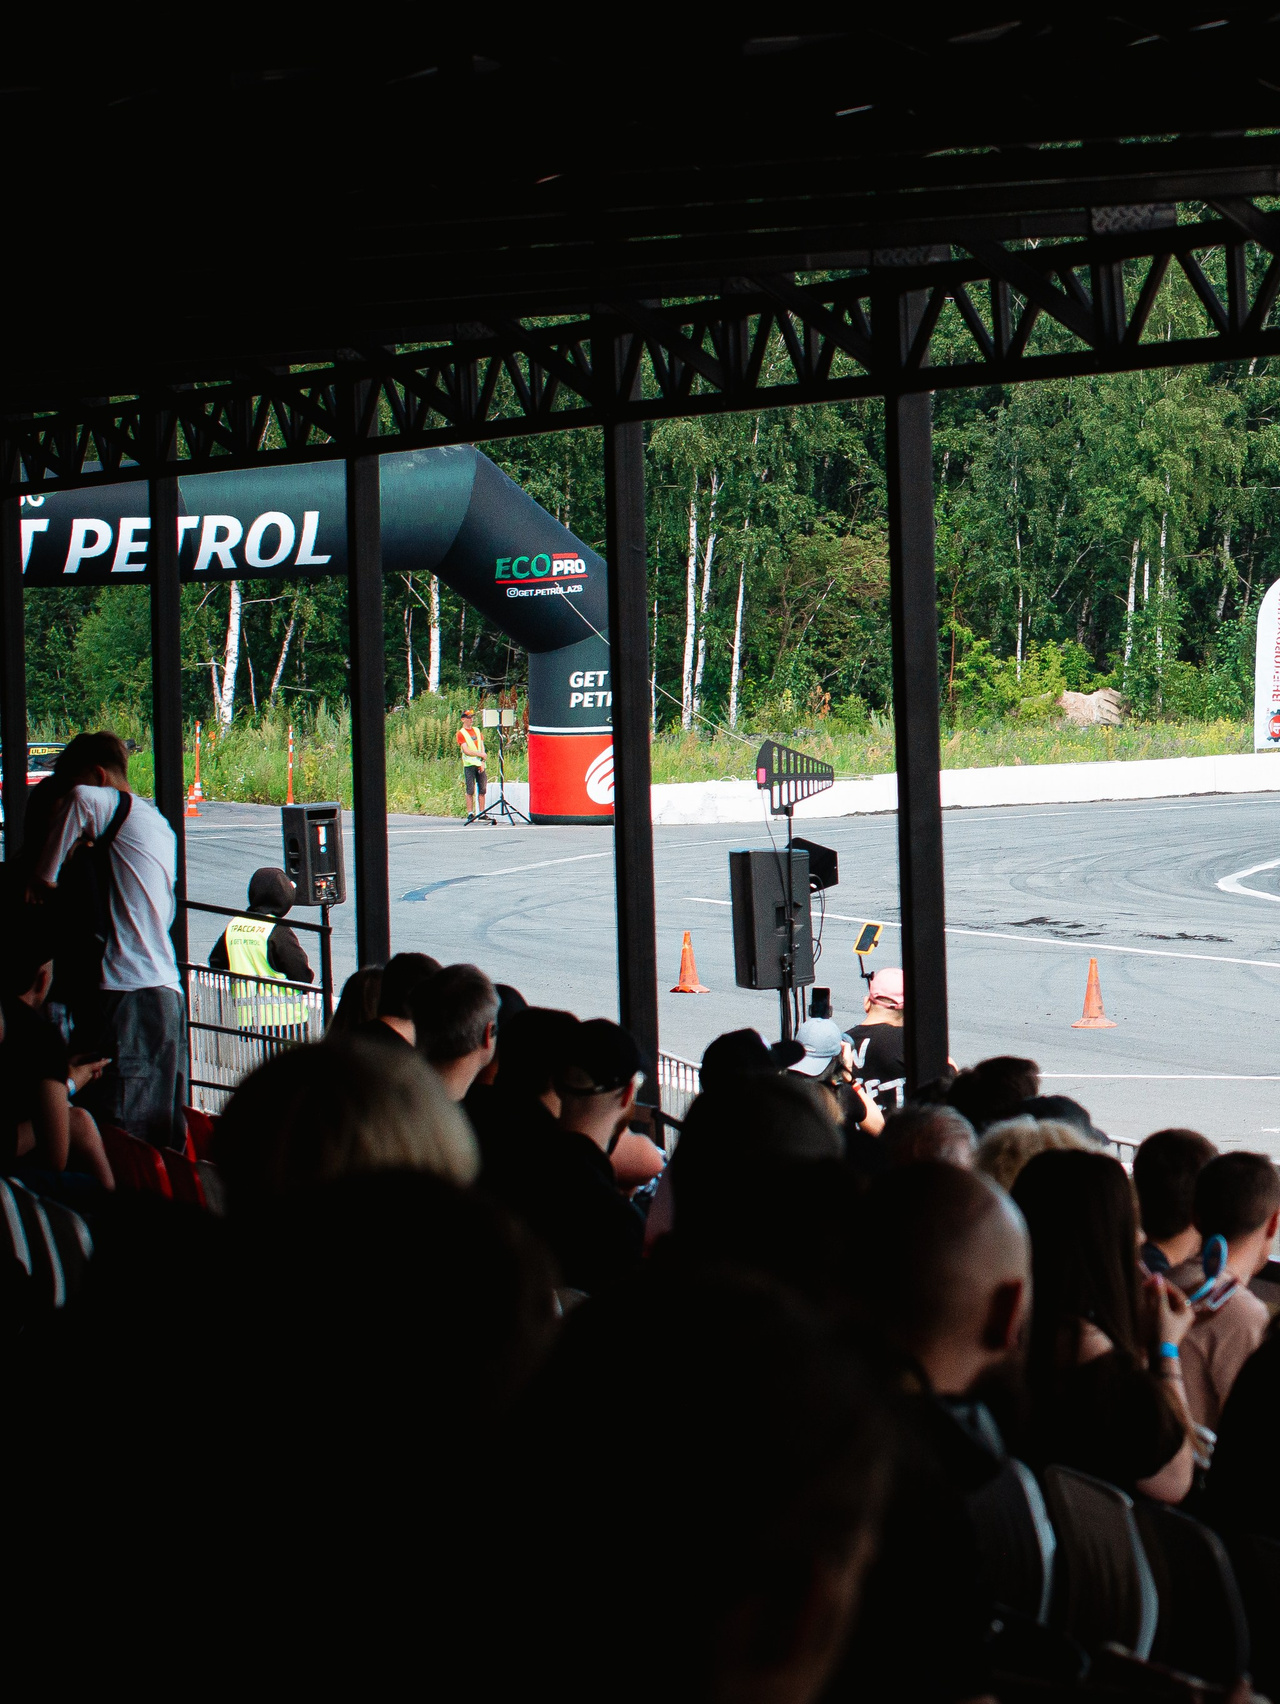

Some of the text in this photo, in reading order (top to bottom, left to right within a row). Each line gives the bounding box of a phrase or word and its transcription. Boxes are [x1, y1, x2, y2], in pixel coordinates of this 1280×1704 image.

[495, 553, 586, 579] ECO PRO
[569, 670, 609, 688] GET
[569, 691, 612, 708] PET
